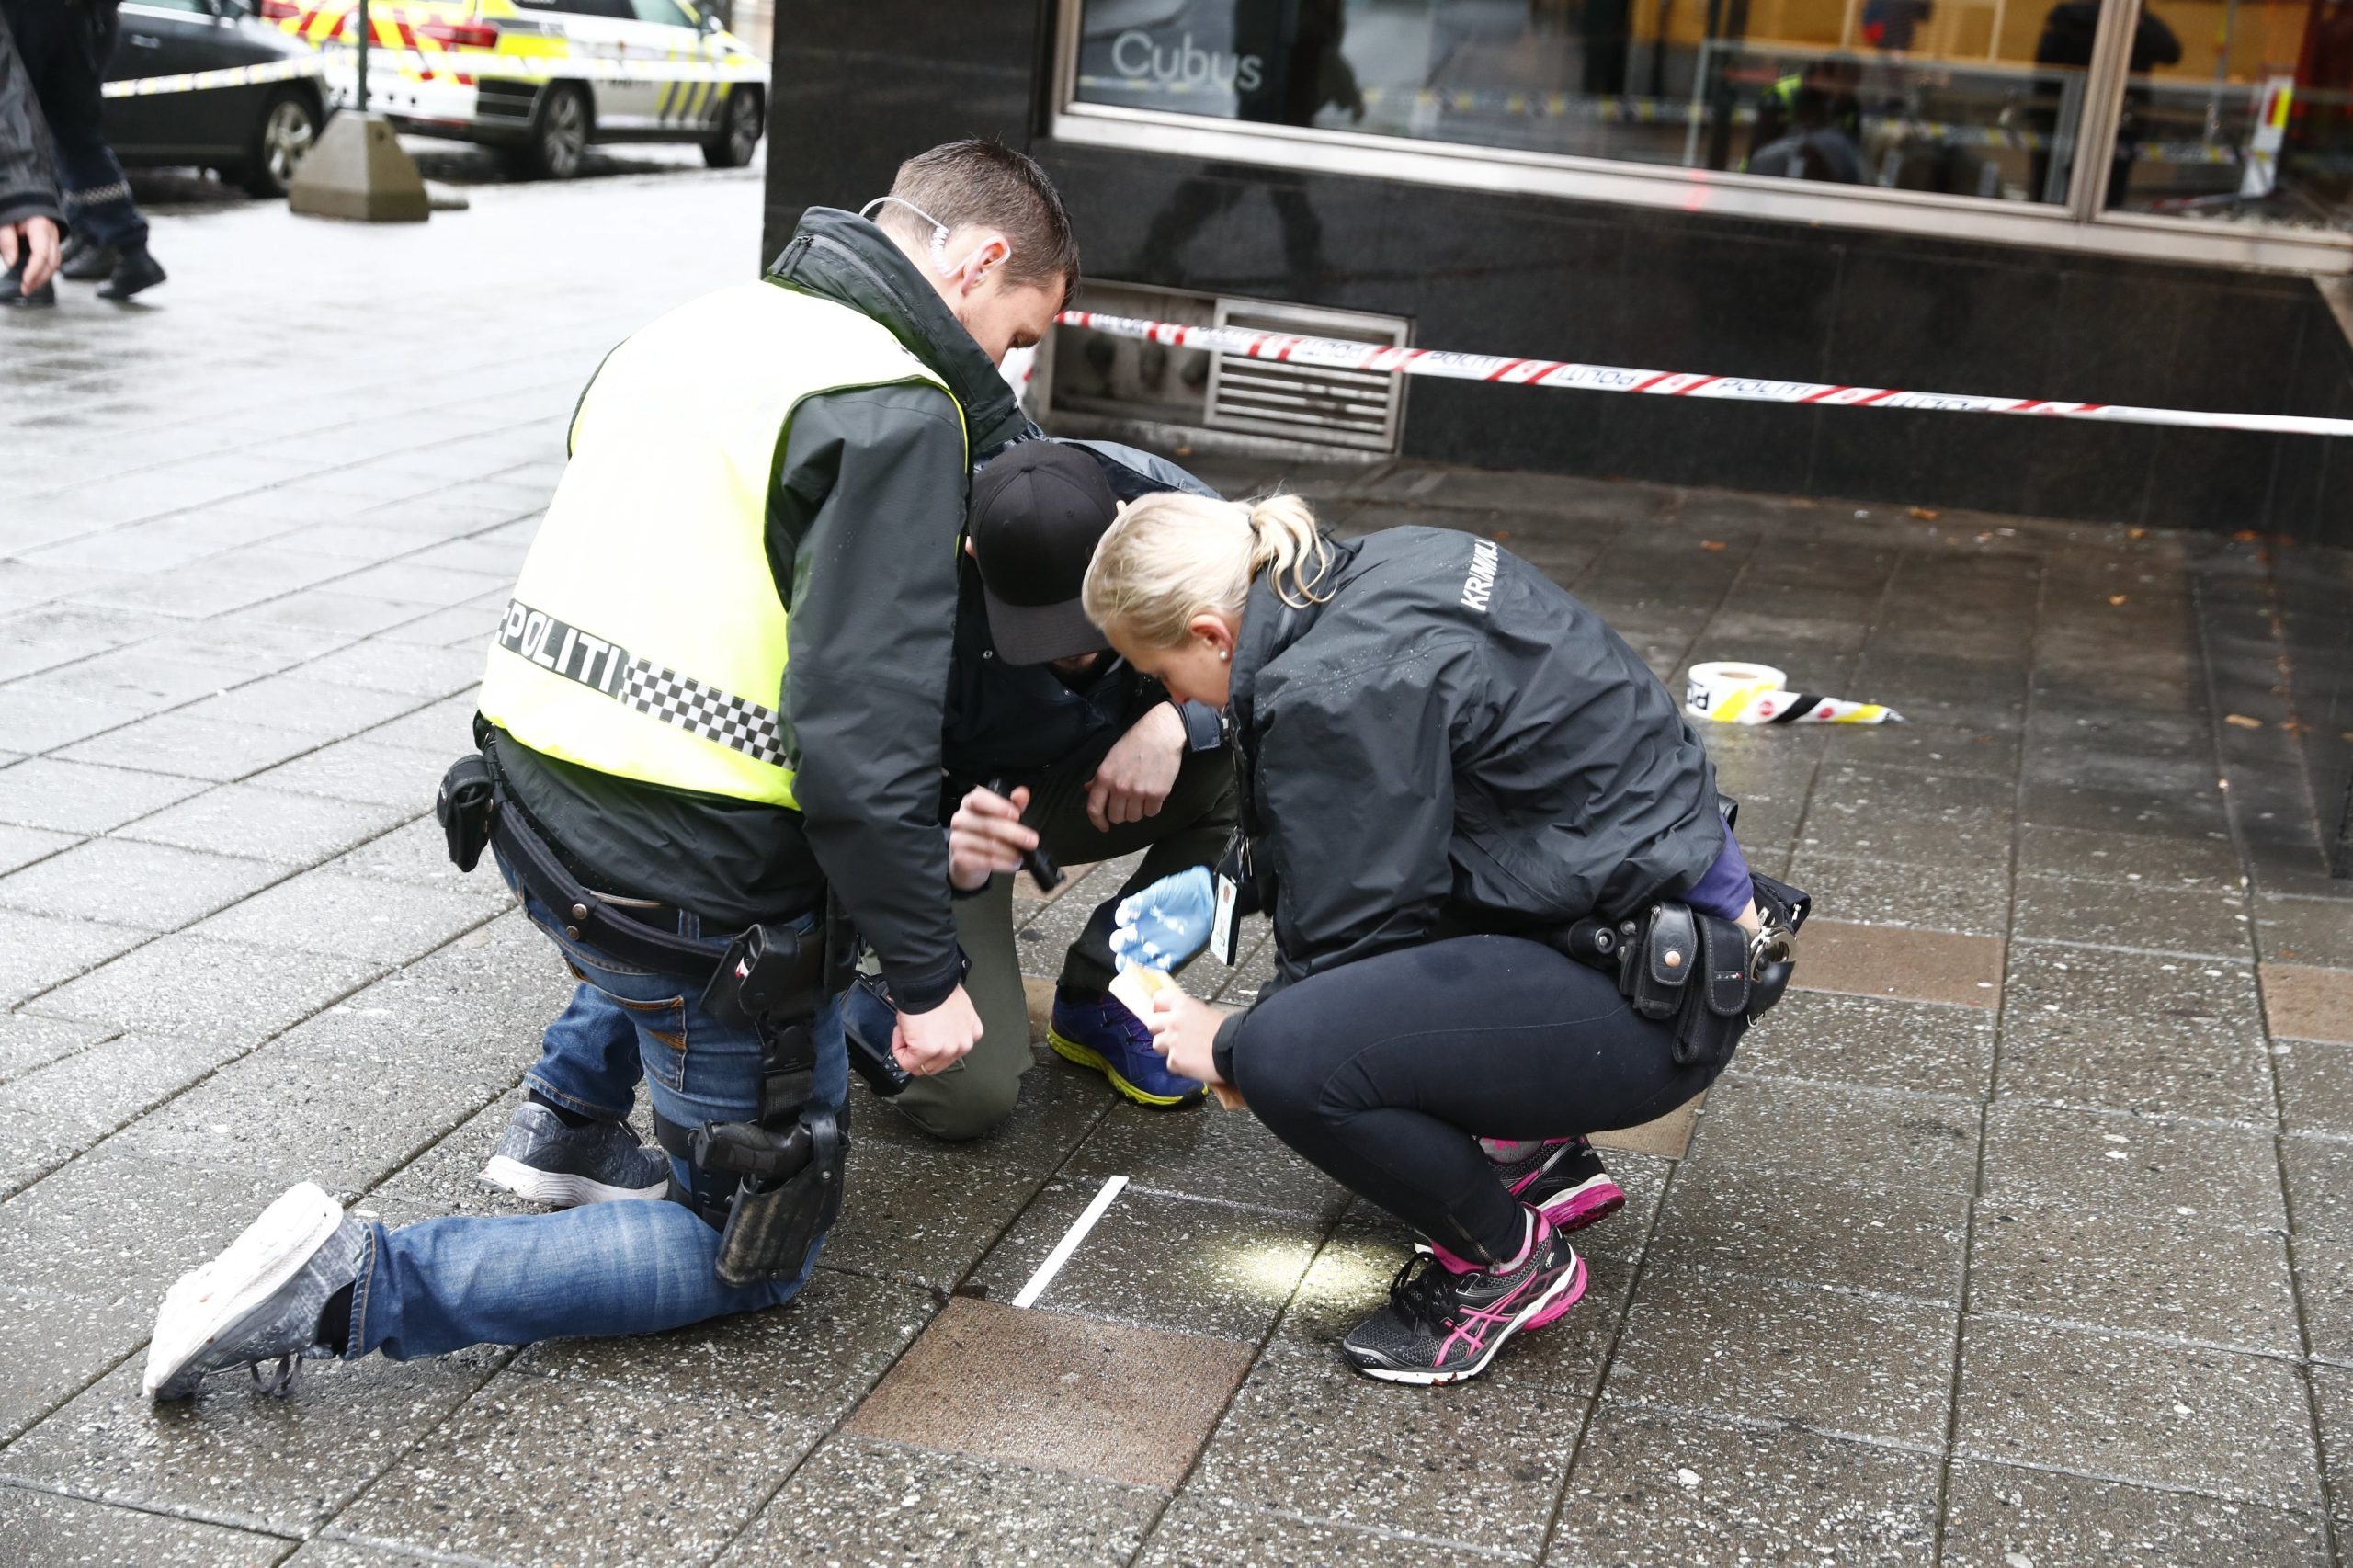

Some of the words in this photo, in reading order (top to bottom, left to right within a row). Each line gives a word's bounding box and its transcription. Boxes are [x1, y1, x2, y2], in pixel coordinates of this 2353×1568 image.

[1111, 29, 1263, 90] Cubus
[1558, 366, 1637, 386] POLITI
[1718, 378, 1815, 396] POLITI
[501, 601, 621, 693] POLITI
